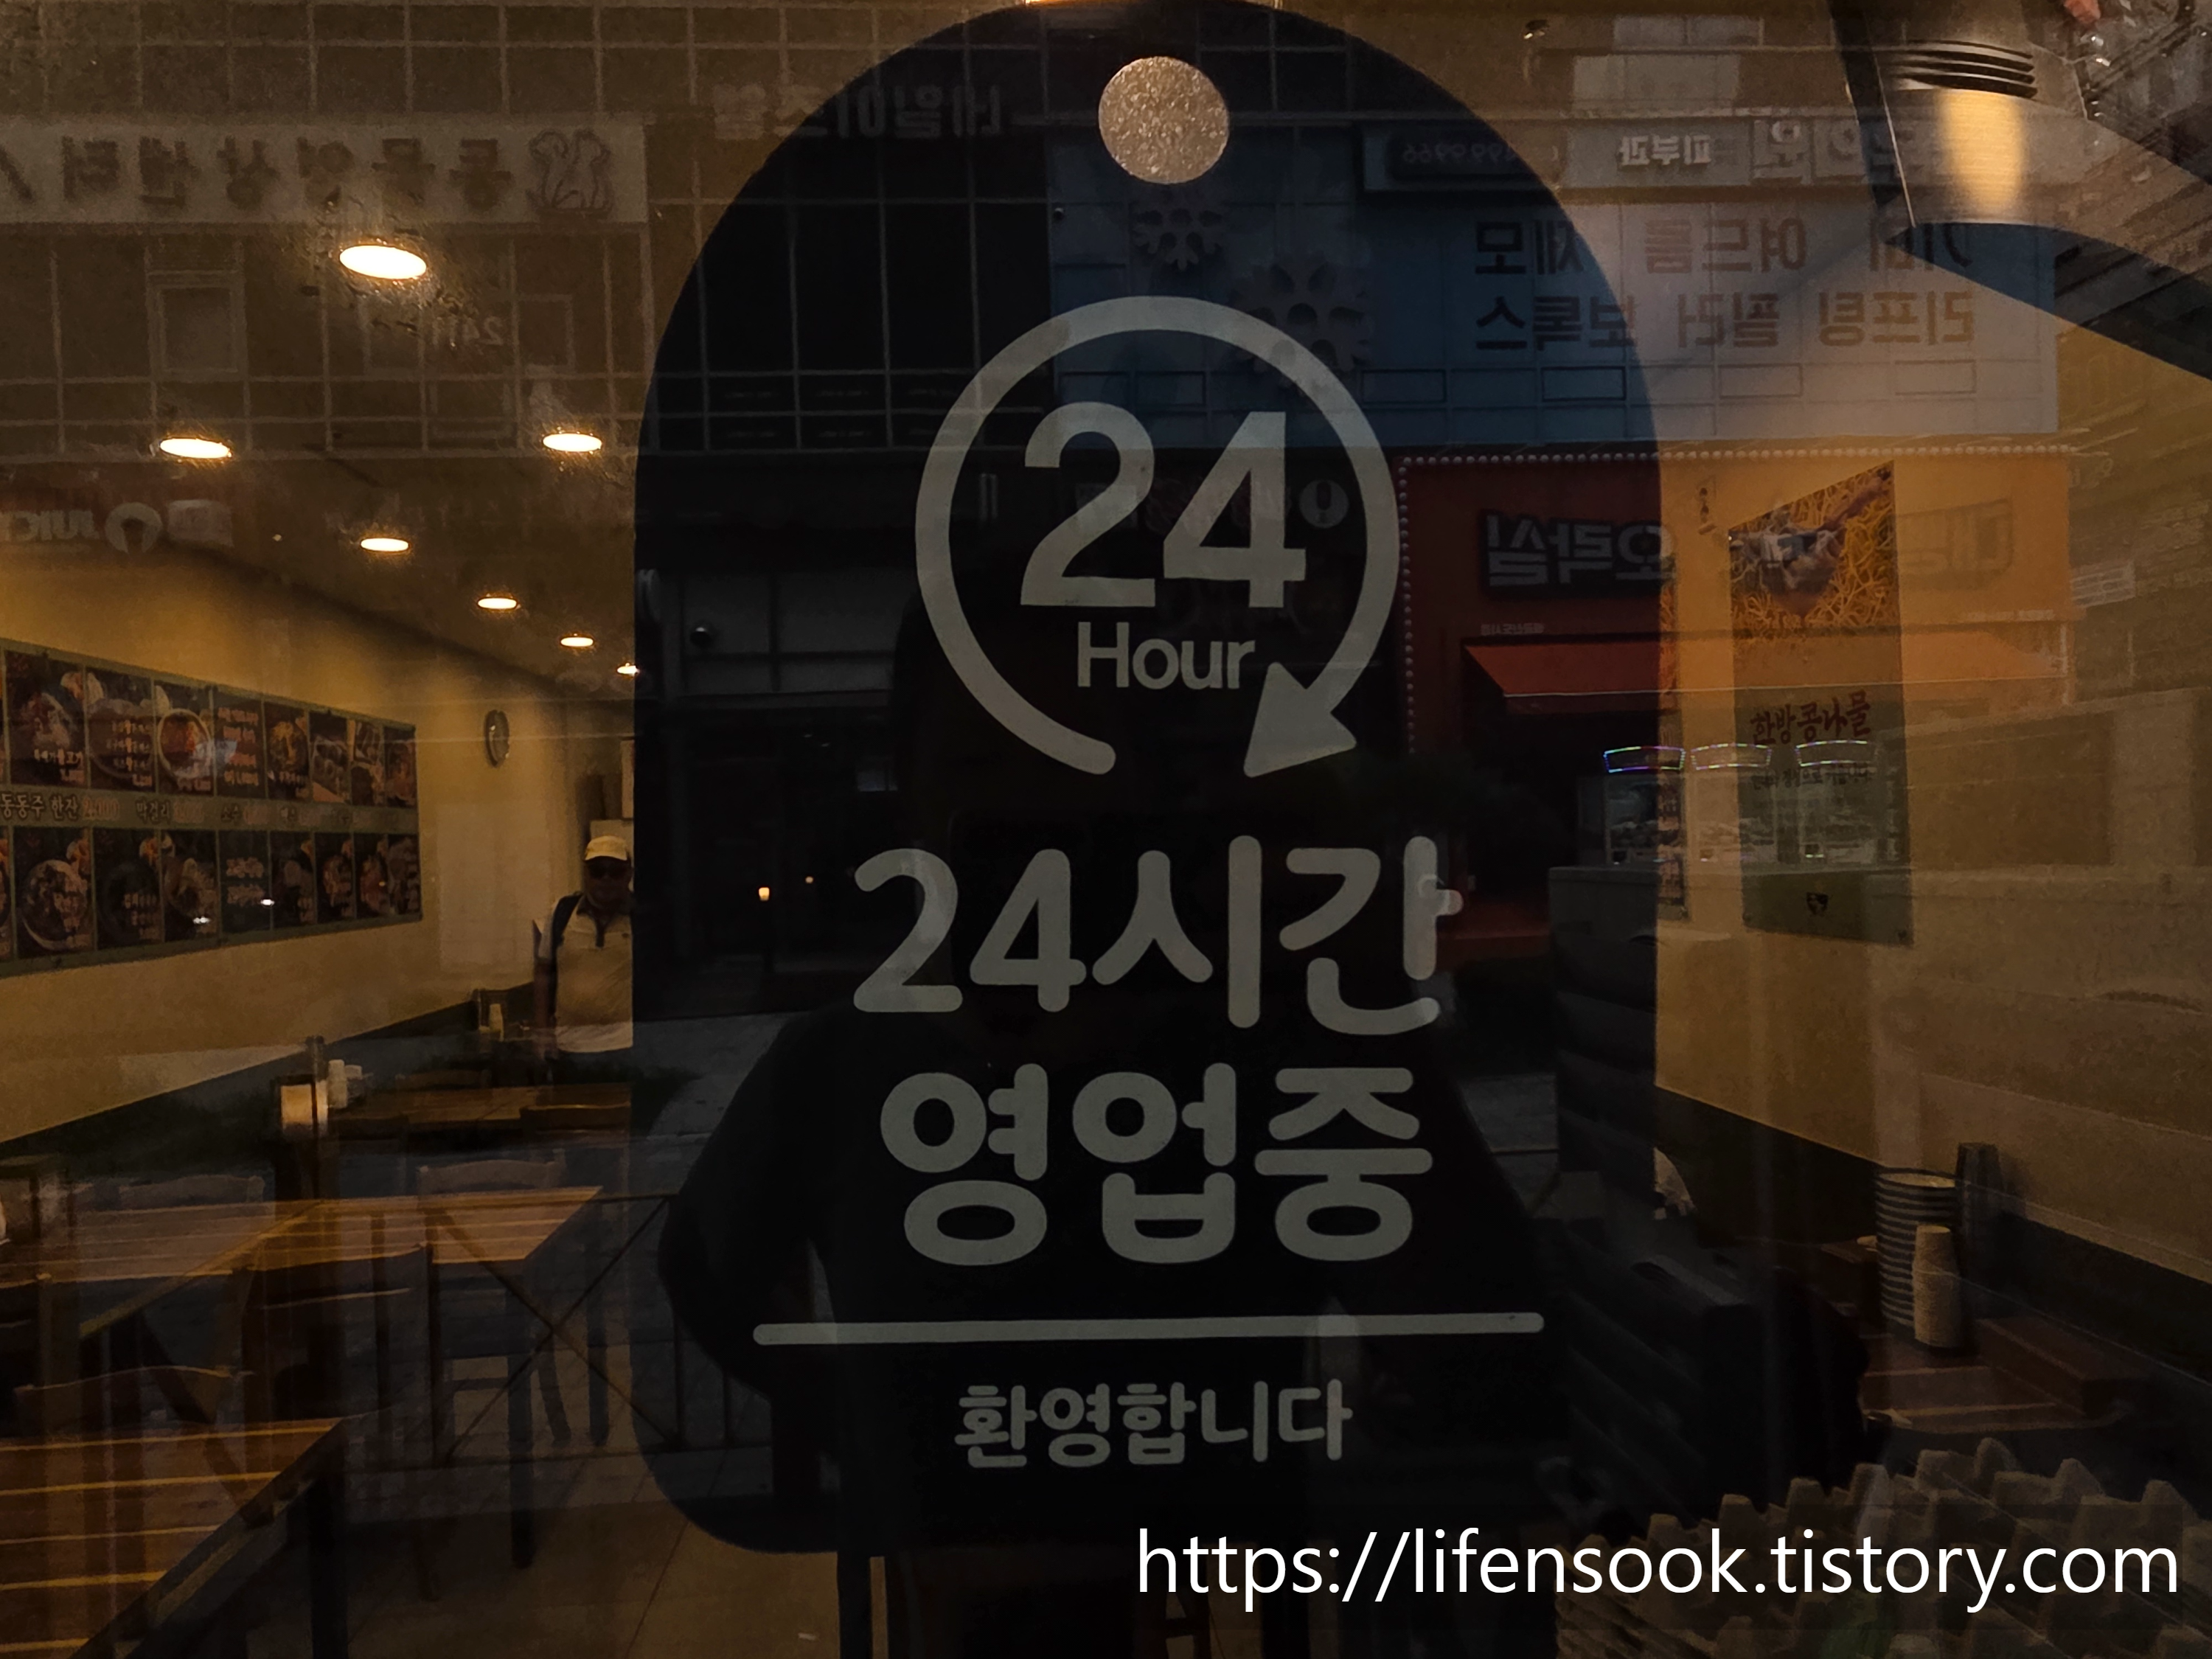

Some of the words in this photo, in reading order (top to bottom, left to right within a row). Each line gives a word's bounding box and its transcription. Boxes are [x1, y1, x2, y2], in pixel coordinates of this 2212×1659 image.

[1020, 401, 1306, 609] 24
[1078, 621, 1256, 691] Hour
[0, 793, 46, 820] 동동주
[854, 835, 1463, 1036] 24시간
[880, 1062, 1433, 1267] 영업중
[954, 1378, 1354, 1471] 환영합니다
